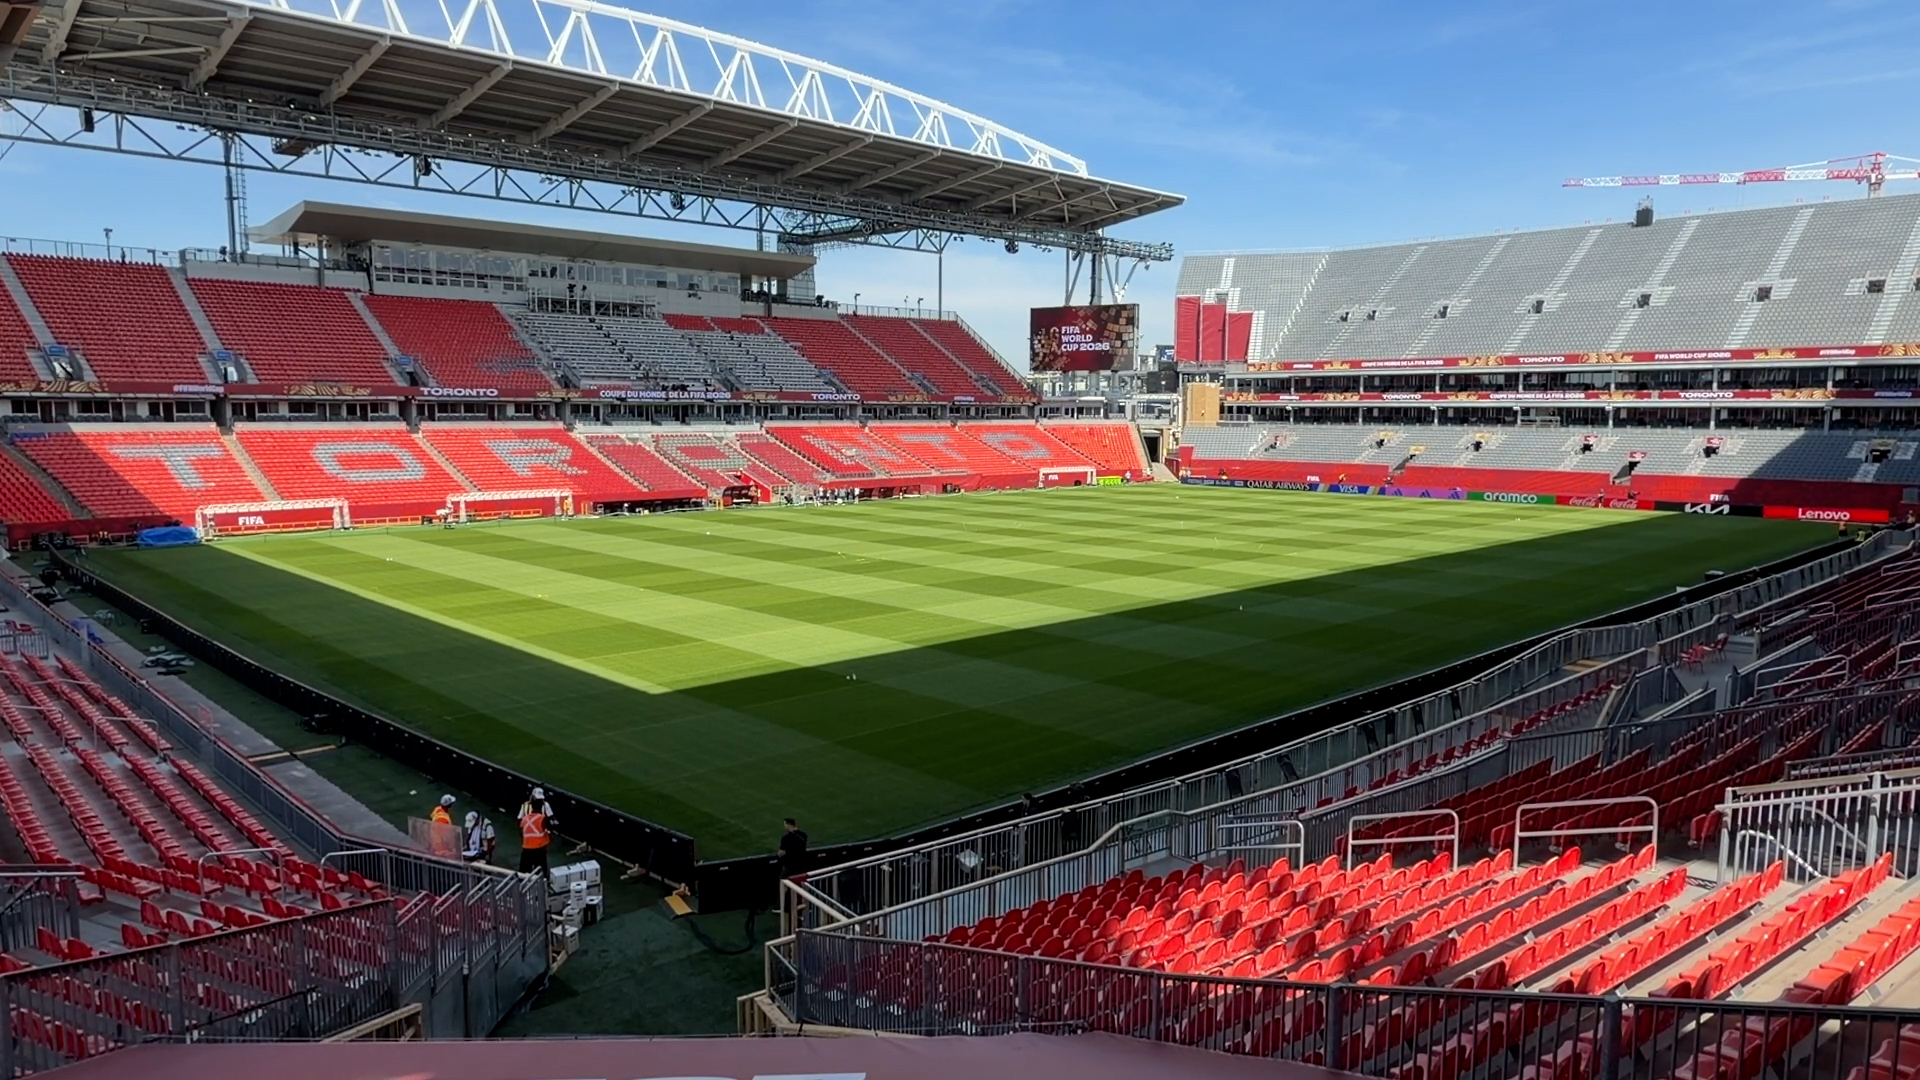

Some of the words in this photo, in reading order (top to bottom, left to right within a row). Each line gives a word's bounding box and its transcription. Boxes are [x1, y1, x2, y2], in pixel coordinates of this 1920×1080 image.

[1061, 326, 1080, 334] FIFA
[1061, 335, 1093, 343] WORLD
[1061, 343, 1079, 351] CUP
[1080, 342, 1110, 351] 2026
[420, 387, 498, 397] TORONTO
[599, 390, 626, 399] COUPE
[627, 390, 638, 399] DU
[639, 390, 667, 399] MONDE
[668, 390, 679, 399] DE
[679, 390, 690, 399] LA
[690, 391, 706, 399] FIFA
[706, 391, 731, 399] 2026
[811, 393, 861, 401] TORONTO
[1247, 480, 1274, 489] QATAR
[1275, 482, 1310, 491] AIRWAYS
[1339, 484, 1359, 493] VISA
[1484, 491, 1538, 504] aramco
[1710, 493, 1730, 501] FIFA
[1798, 507, 1850, 520] Lenovo
[238, 516, 265, 526] FIFA
